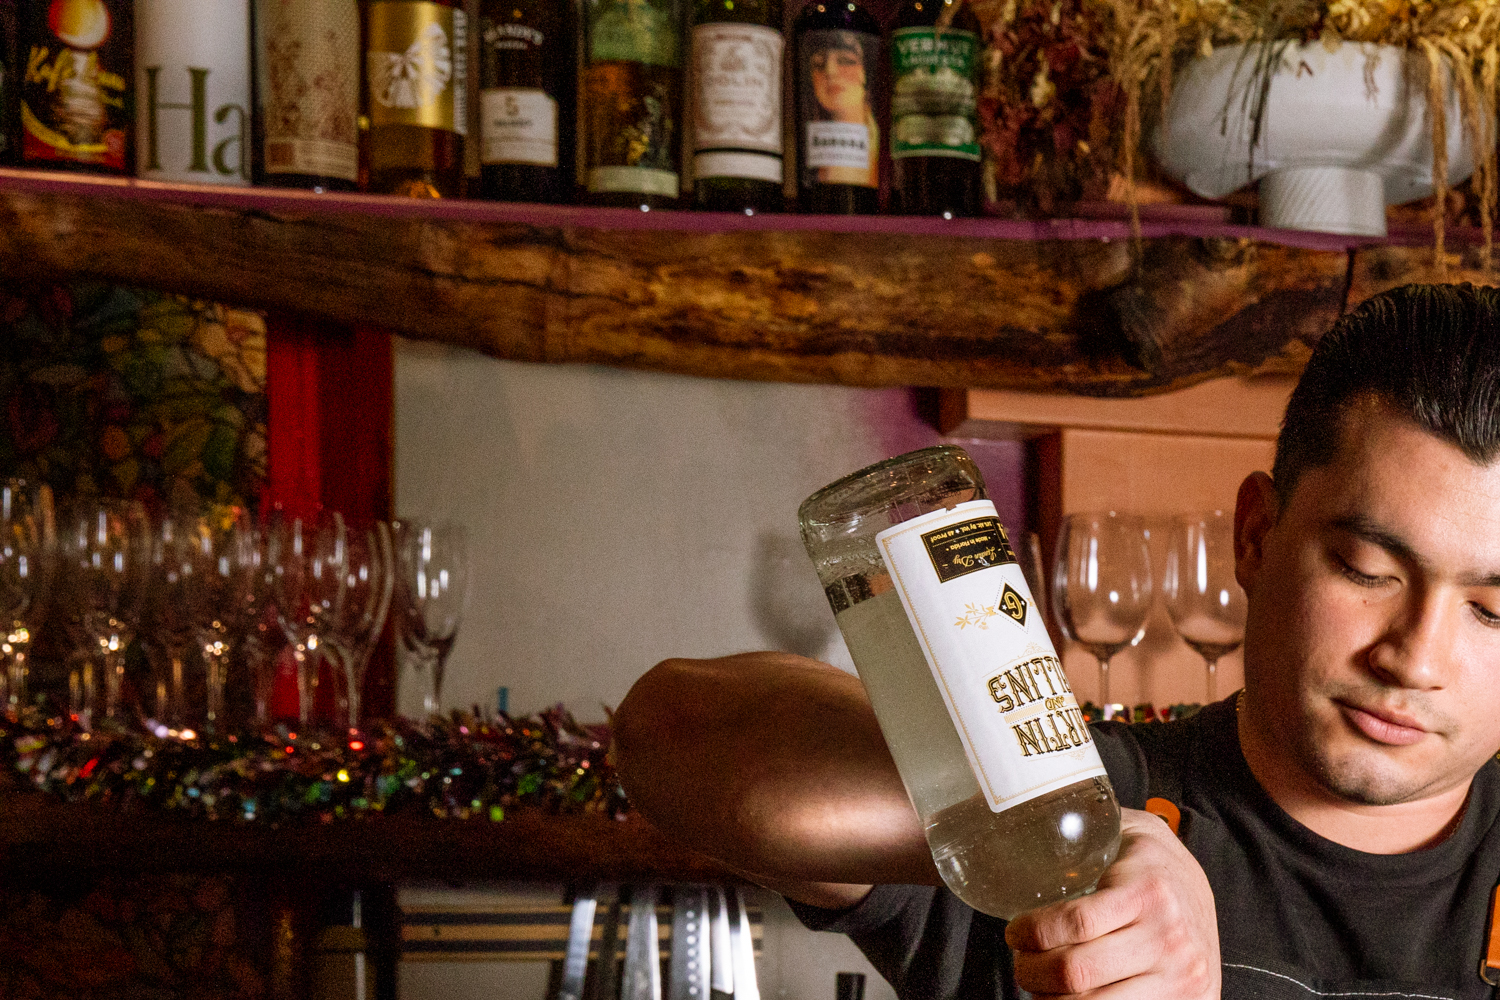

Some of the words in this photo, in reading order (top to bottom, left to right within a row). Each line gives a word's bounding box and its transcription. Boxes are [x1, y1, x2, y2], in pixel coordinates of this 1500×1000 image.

[950, 540, 970, 550] Florida
[952, 554, 974, 567] Dry
[1045, 696, 1066, 711] AND
